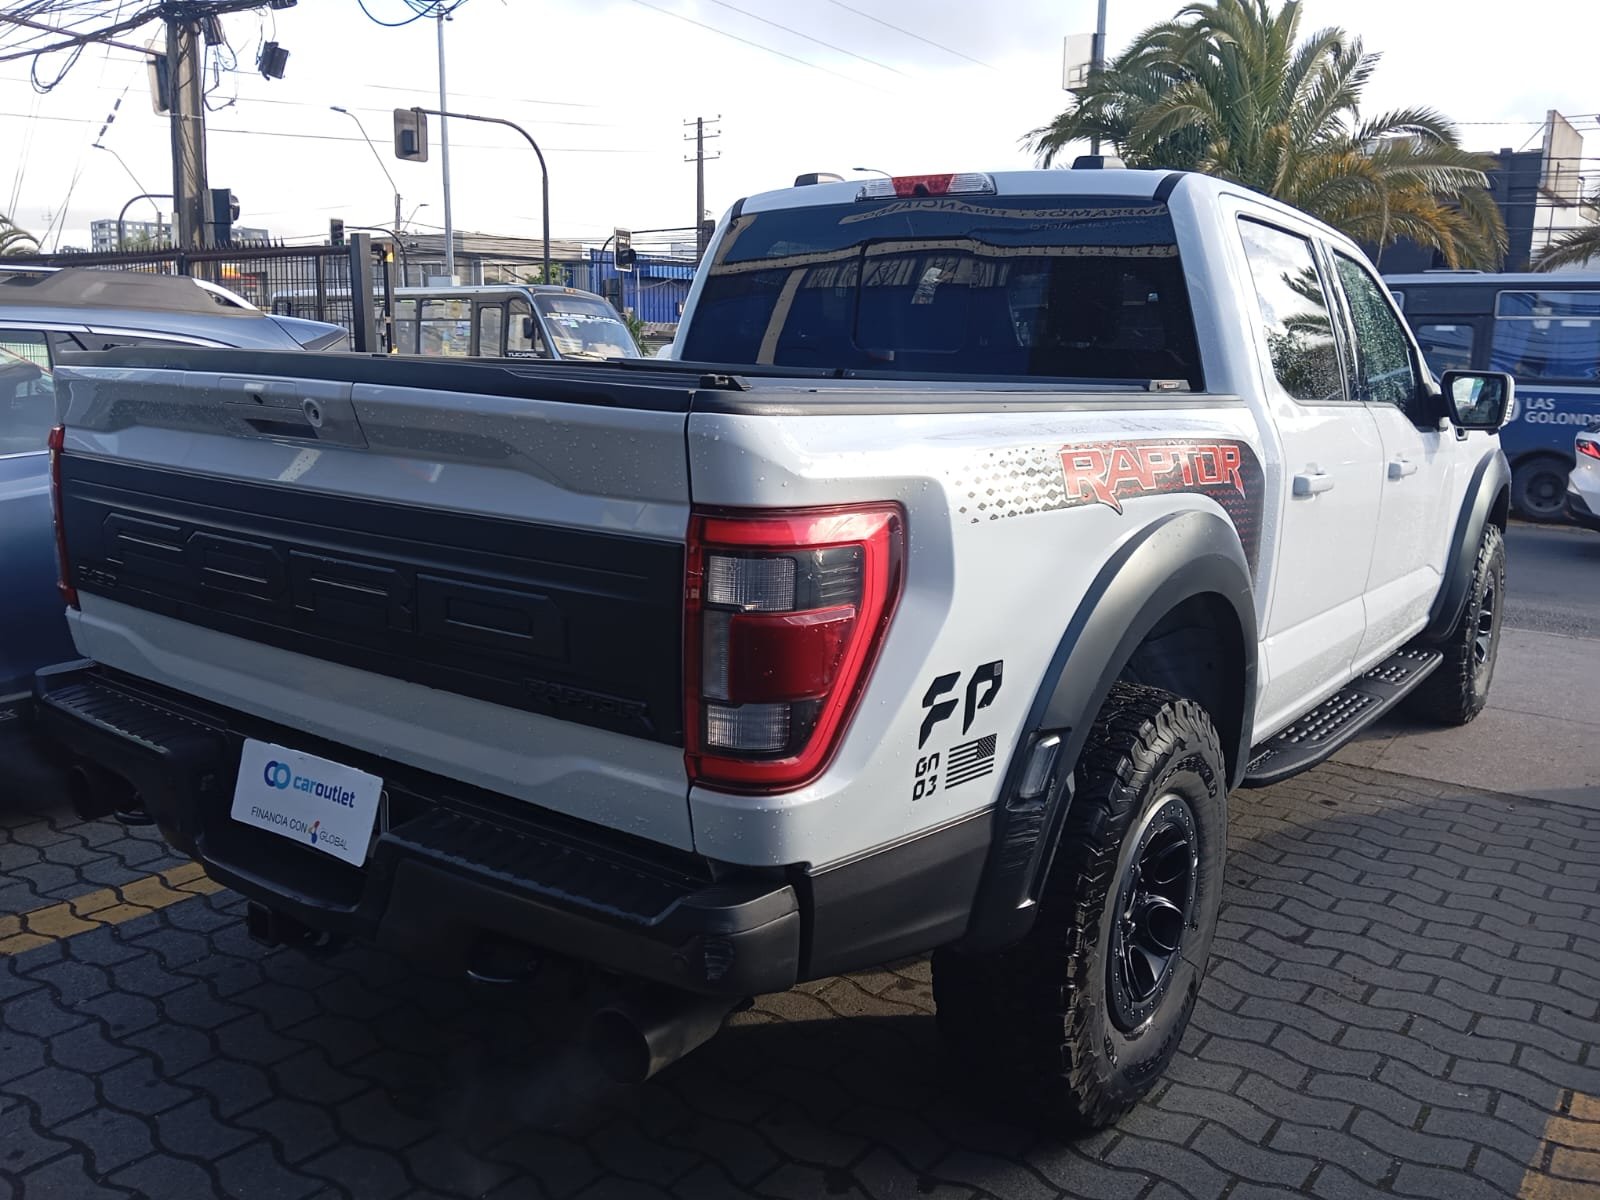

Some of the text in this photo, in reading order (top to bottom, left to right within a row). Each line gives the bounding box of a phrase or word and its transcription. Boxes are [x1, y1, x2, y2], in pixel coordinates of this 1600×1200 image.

[1526, 397, 1556, 410] LAS
[1059, 445, 1246, 515] RAPTOR
[102, 511, 570, 664] FORD
[293, 775, 356, 808] caroutlet
[251, 806, 348, 850] FINANCIA CON GLOBAL
